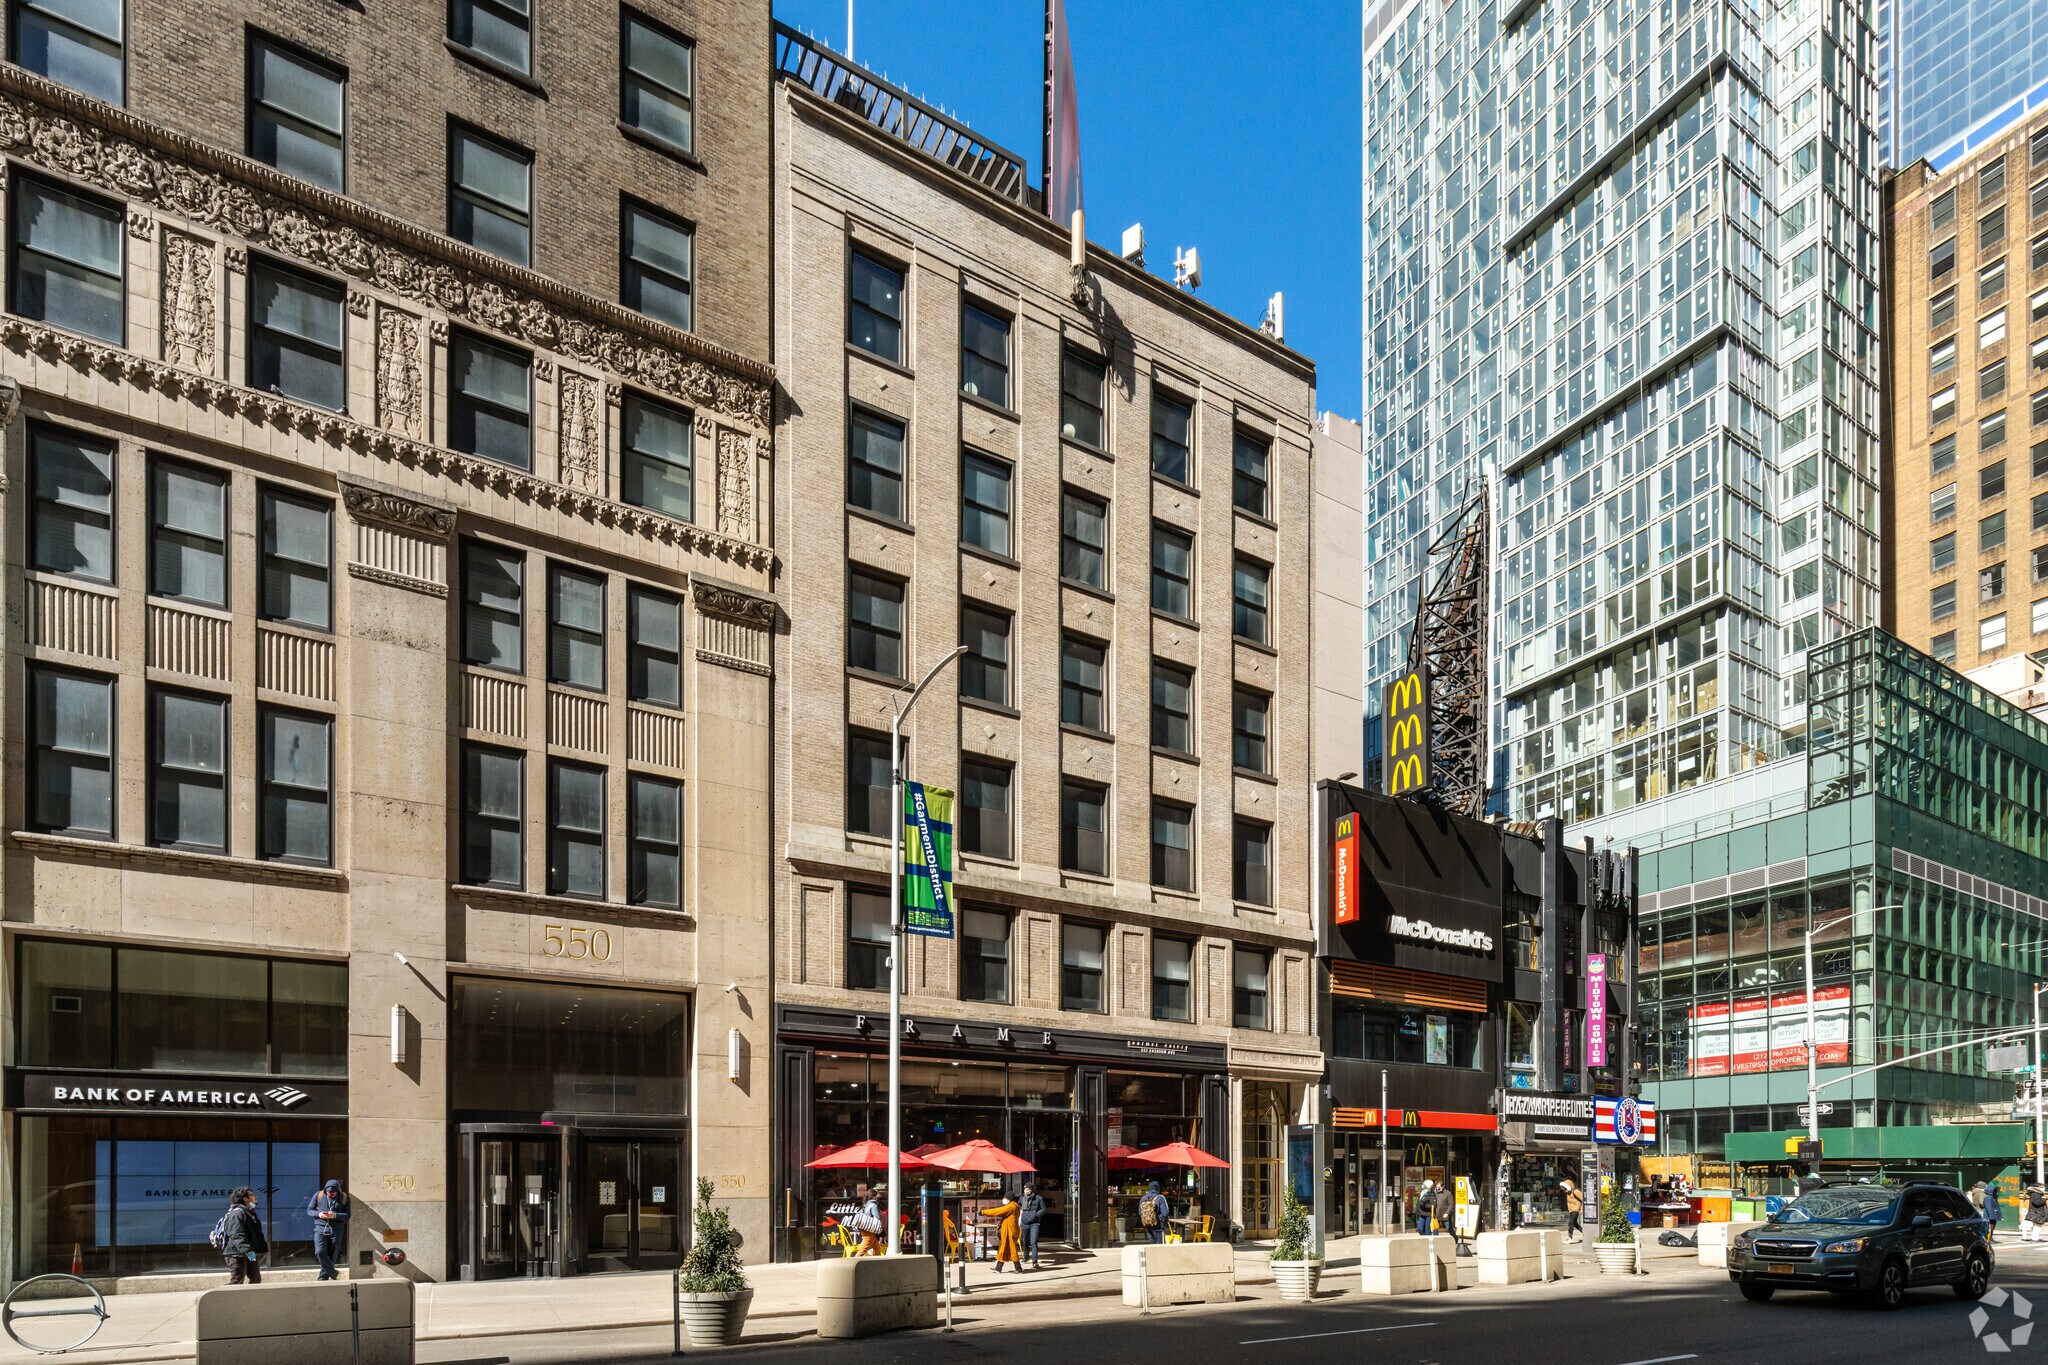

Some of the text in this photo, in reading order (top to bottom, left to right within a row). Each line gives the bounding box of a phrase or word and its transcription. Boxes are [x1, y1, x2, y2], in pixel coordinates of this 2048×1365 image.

[914, 792, 944, 900] #GarmentDistrict
[1338, 847, 1347, 918] McDonald's
[543, 925, 612, 961] 550
[1390, 914, 1494, 951] McDonald's
[1590, 976, 1602, 1020] MIDTOWN
[855, 1014, 1052, 1045] FRAME
[1591, 1024, 1602, 1063] COMICS
[54, 1086, 260, 1105] BANK OF AMERICA
[145, 1189, 179, 1197] BANK
[381, 1174, 415, 1190] 550
[721, 1175, 746, 1188] 550
